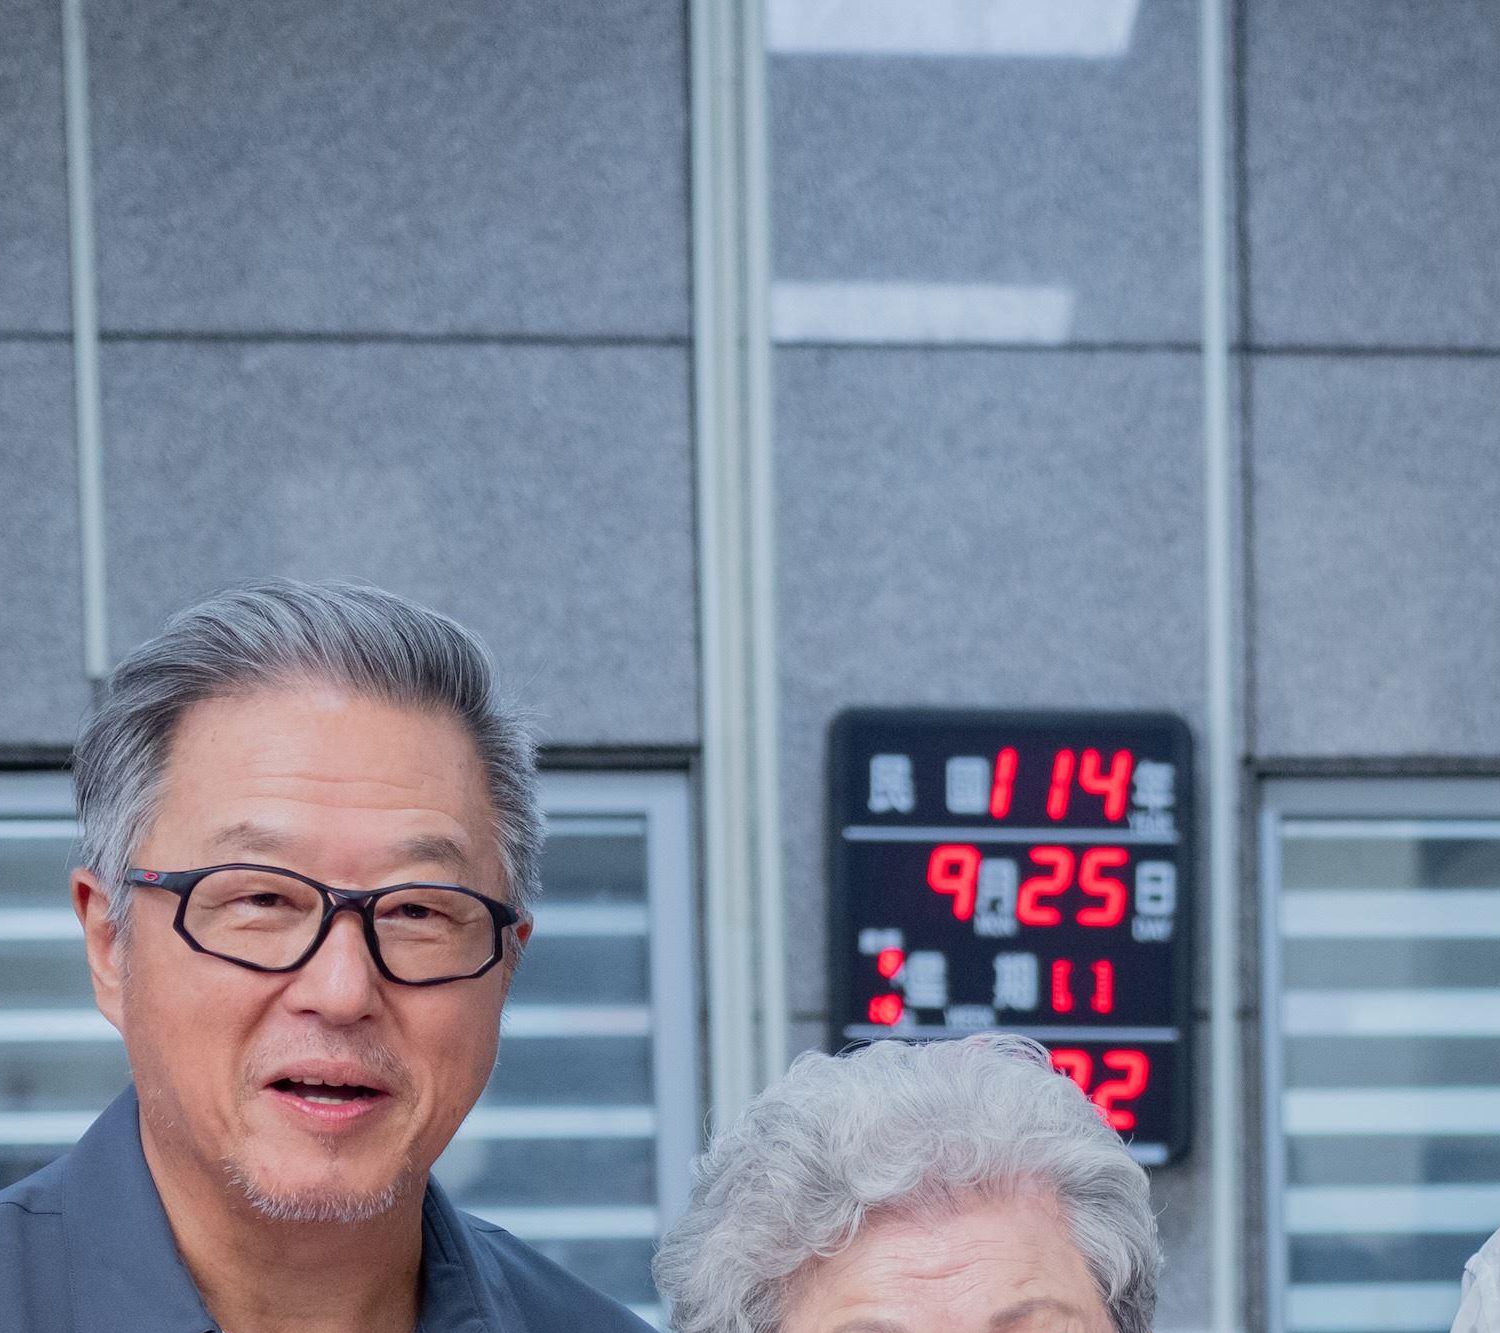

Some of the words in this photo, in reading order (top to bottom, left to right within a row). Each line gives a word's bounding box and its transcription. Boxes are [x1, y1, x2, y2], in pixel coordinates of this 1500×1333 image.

[989, 746, 1134, 822] 114
[927, 844, 982, 922] 9
[1016, 845, 1129, 927] 25
